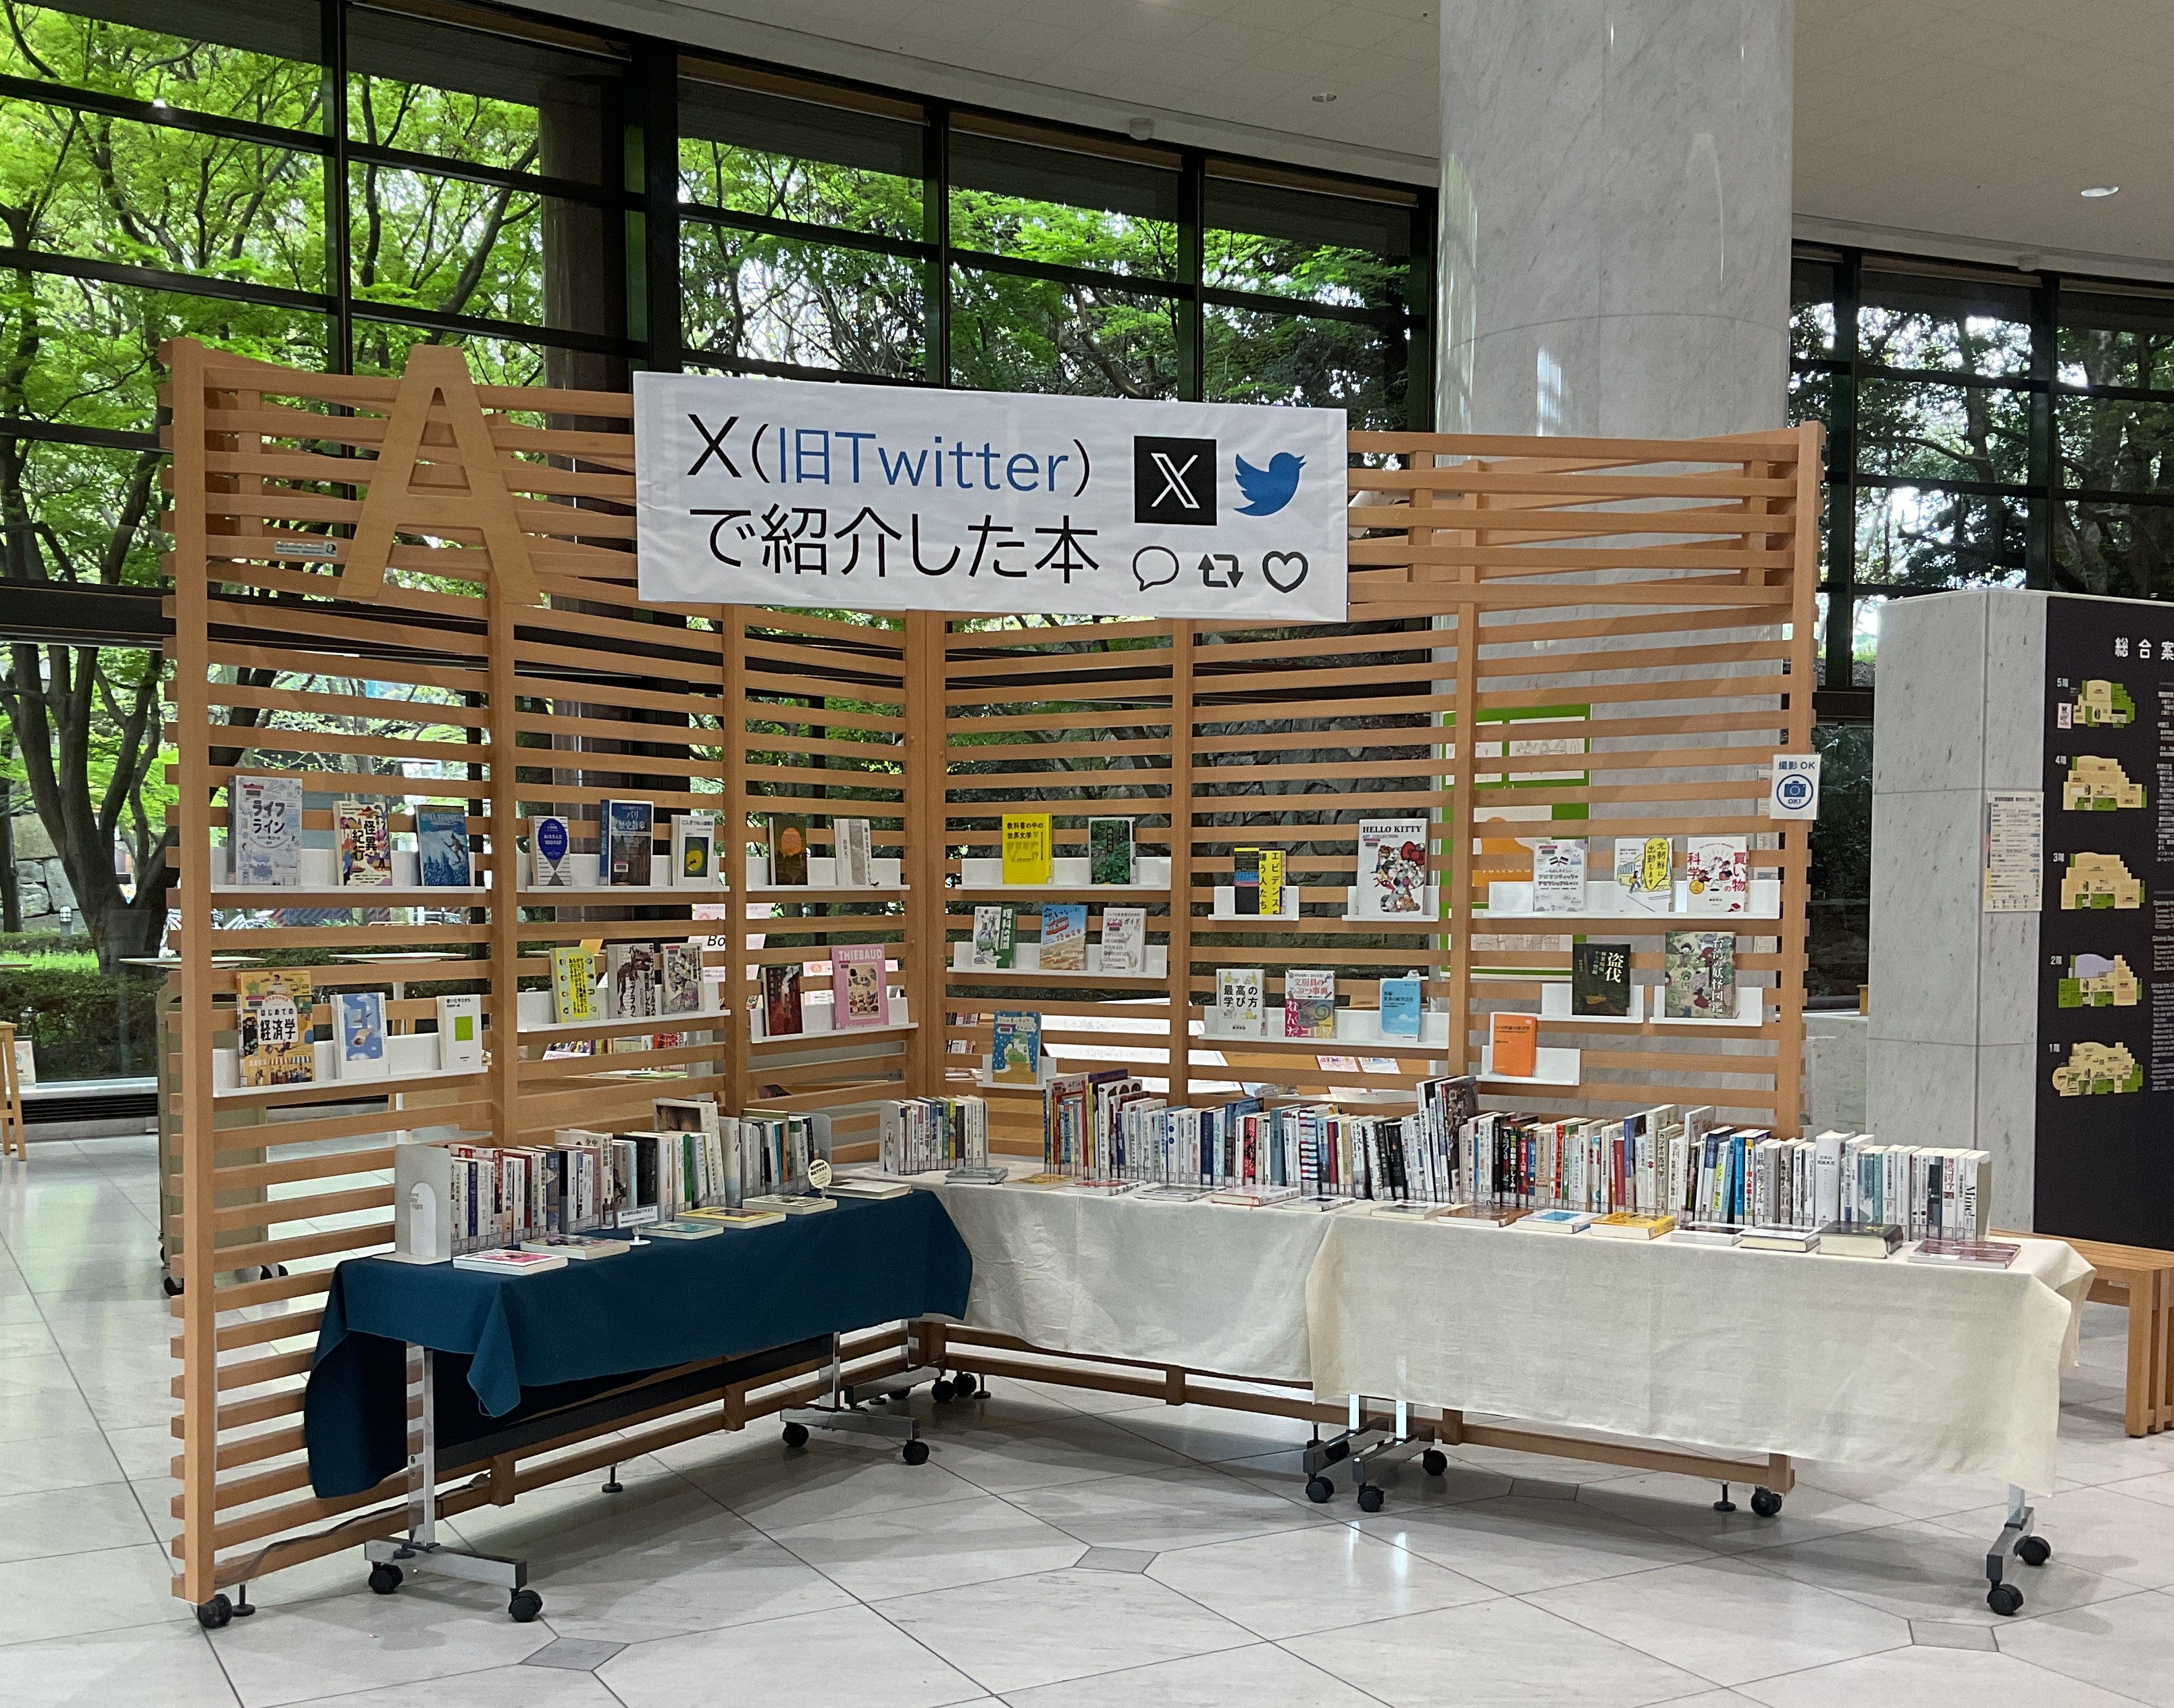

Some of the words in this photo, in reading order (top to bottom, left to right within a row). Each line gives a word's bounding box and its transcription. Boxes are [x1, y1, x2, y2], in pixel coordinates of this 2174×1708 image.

[688, 413, 1091, 498] X(旧Twitter)
[689, 503, 1099, 584] で紹介した本
[1778, 761, 1798, 770] 撮影
[1800, 761, 1815, 770] OK
[253, 800, 286, 817] ライフ
[626, 810, 640, 819] パリ
[253, 819, 285, 834] ライン
[1006, 831, 1033, 839] 世界文学
[1362, 825, 1392, 833] HELLO
[1393, 825, 1422, 833] KITTY
[1647, 846, 1656, 886] 出勤します
[1657, 842, 1667, 877] 北朝鮮に
[1688, 852, 1701, 879] 科学
[838, 949, 883, 960] THIEBAUD
[1605, 952, 1625, 983] 盗伐
[1711, 937, 1724, 1014] 台湾の妖怪図鑑
[1223, 985, 1258, 995] 最高の
[1223, 996, 1258, 1008] 学び方
[260, 1008, 294, 1016] はじめての
[260, 1018, 296, 1041] 経済学
[1657, 1133, 1666, 1177] カツオの古代学
